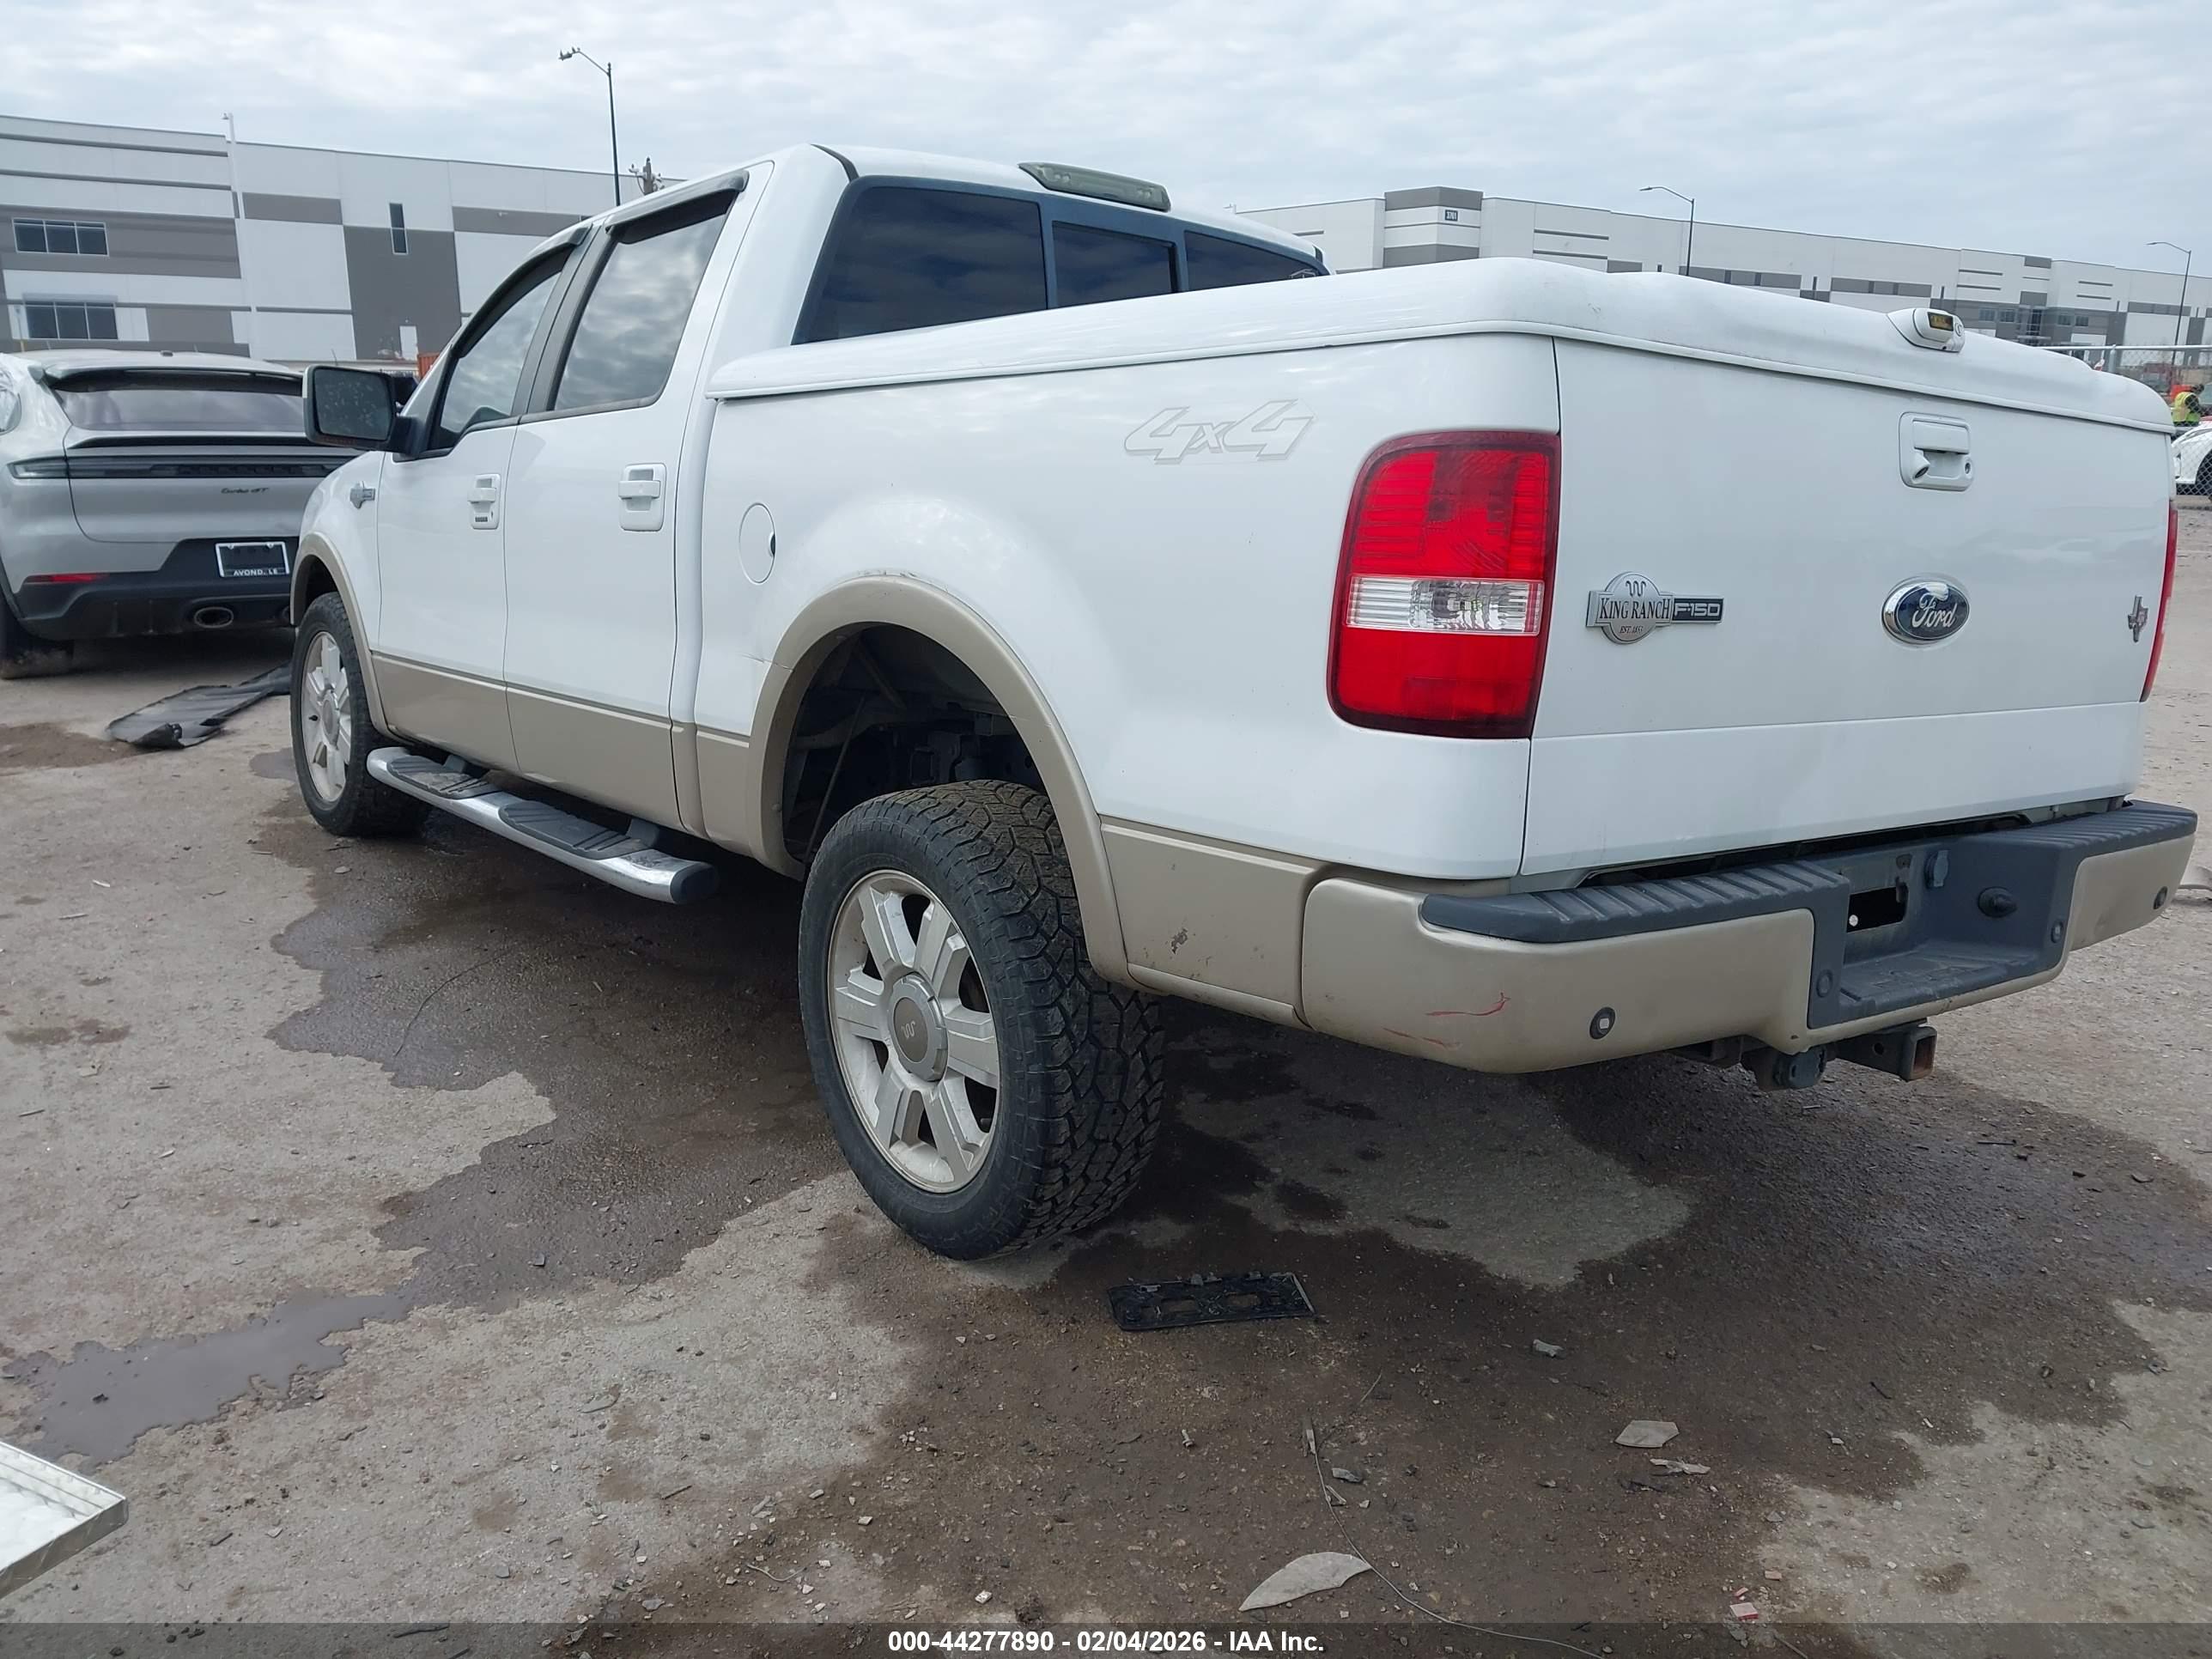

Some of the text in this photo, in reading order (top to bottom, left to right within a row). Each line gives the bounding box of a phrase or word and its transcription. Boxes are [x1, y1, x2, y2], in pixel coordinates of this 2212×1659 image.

[1124, 398, 1314, 465] 4x4
[1600, 598, 1629, 619] KING
[1632, 599, 1671, 619] RANCH
[1911, 592, 1958, 628] Ford
